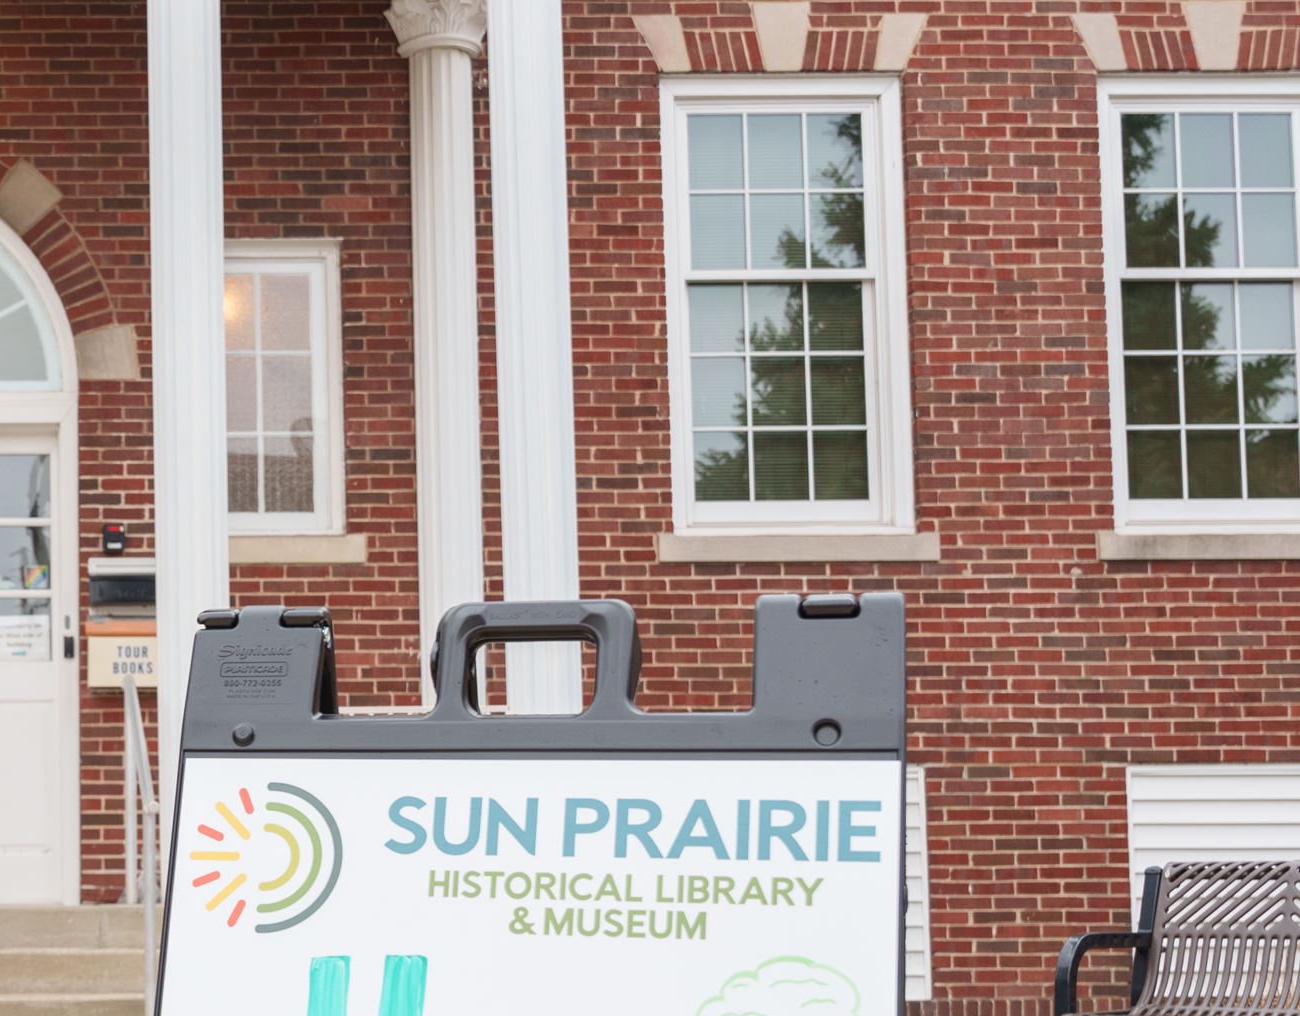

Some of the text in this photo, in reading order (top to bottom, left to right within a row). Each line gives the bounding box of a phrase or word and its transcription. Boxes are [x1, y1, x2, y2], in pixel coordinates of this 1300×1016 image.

[113, 662, 153, 674] BOOKS
[117, 646, 148, 658] TOUR
[384, 795, 883, 863] SUN PRAIRIE
[427, 869, 825, 908] HISTORICAL LIBRARY
[508, 906, 708, 941] & MUSEUM
